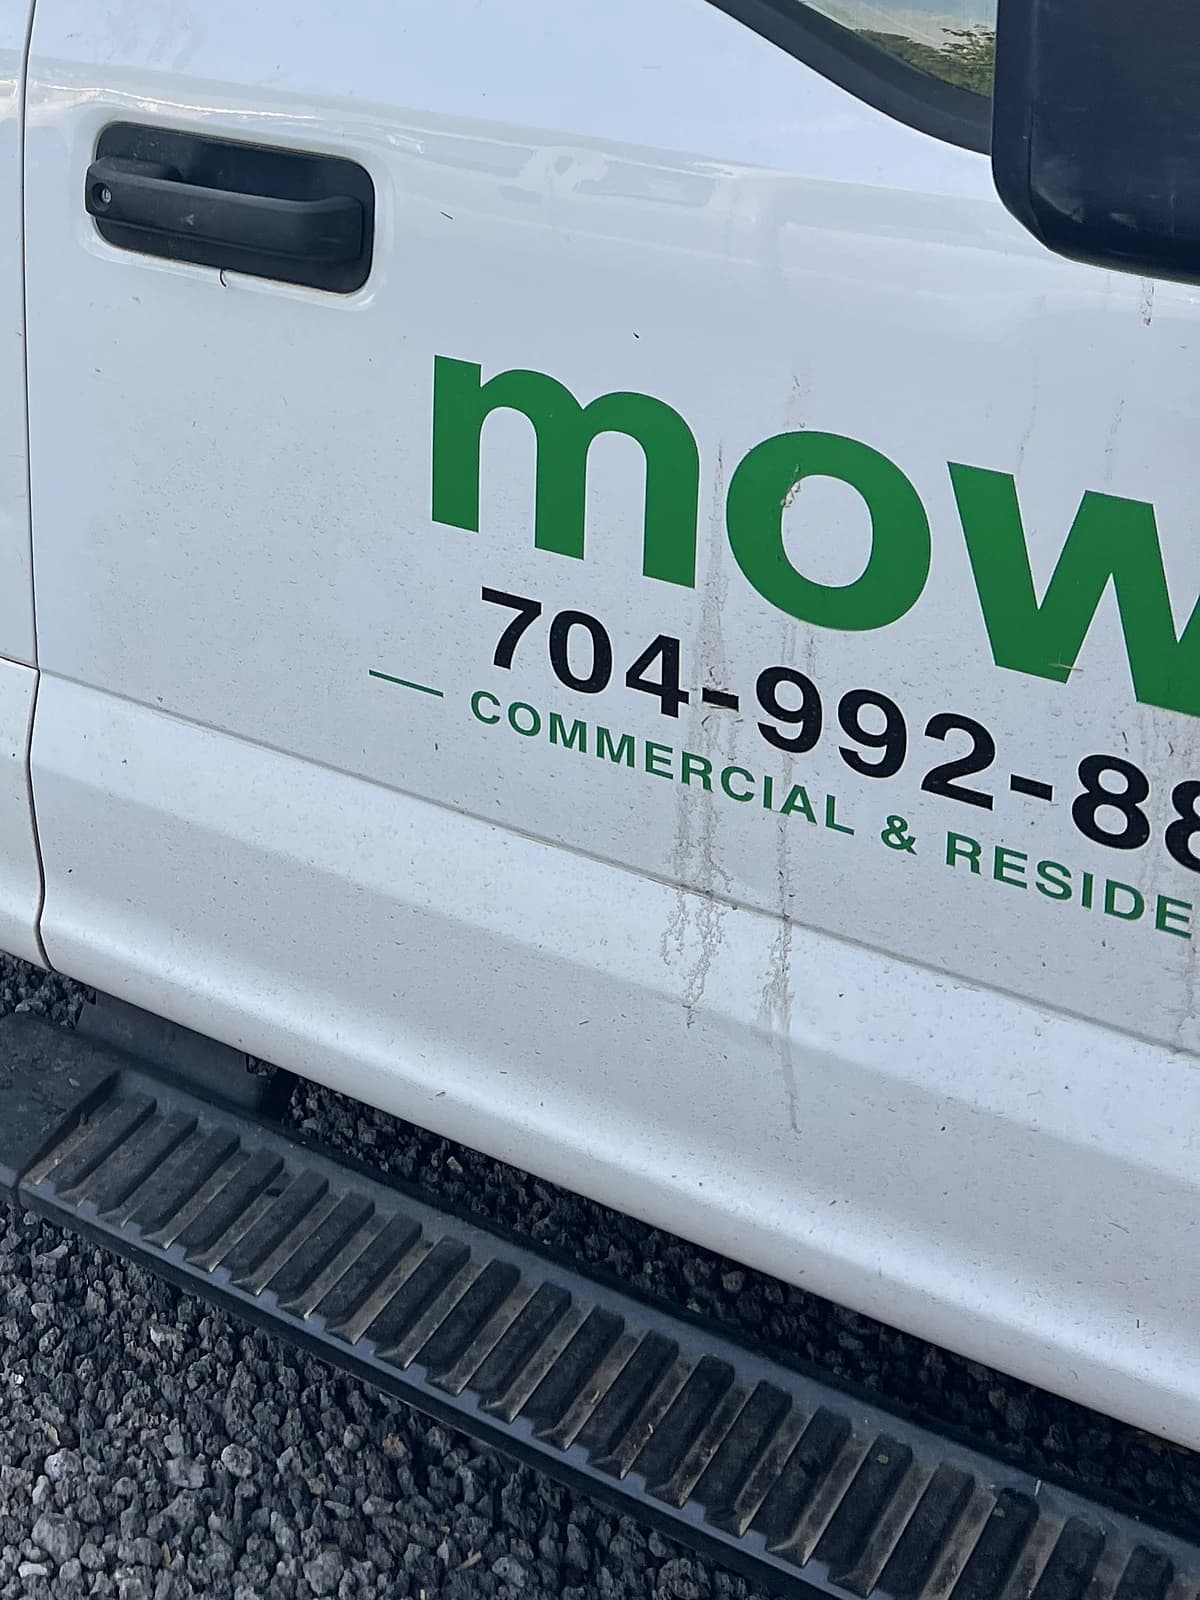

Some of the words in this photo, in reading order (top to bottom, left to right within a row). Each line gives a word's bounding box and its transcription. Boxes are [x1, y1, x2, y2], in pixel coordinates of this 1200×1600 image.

[432, 355, 1200, 718] mow
[471, 690, 853, 836] COMMERCIAL
[881, 815, 915, 854] &
[946, 832, 1193, 939] RESIDE
